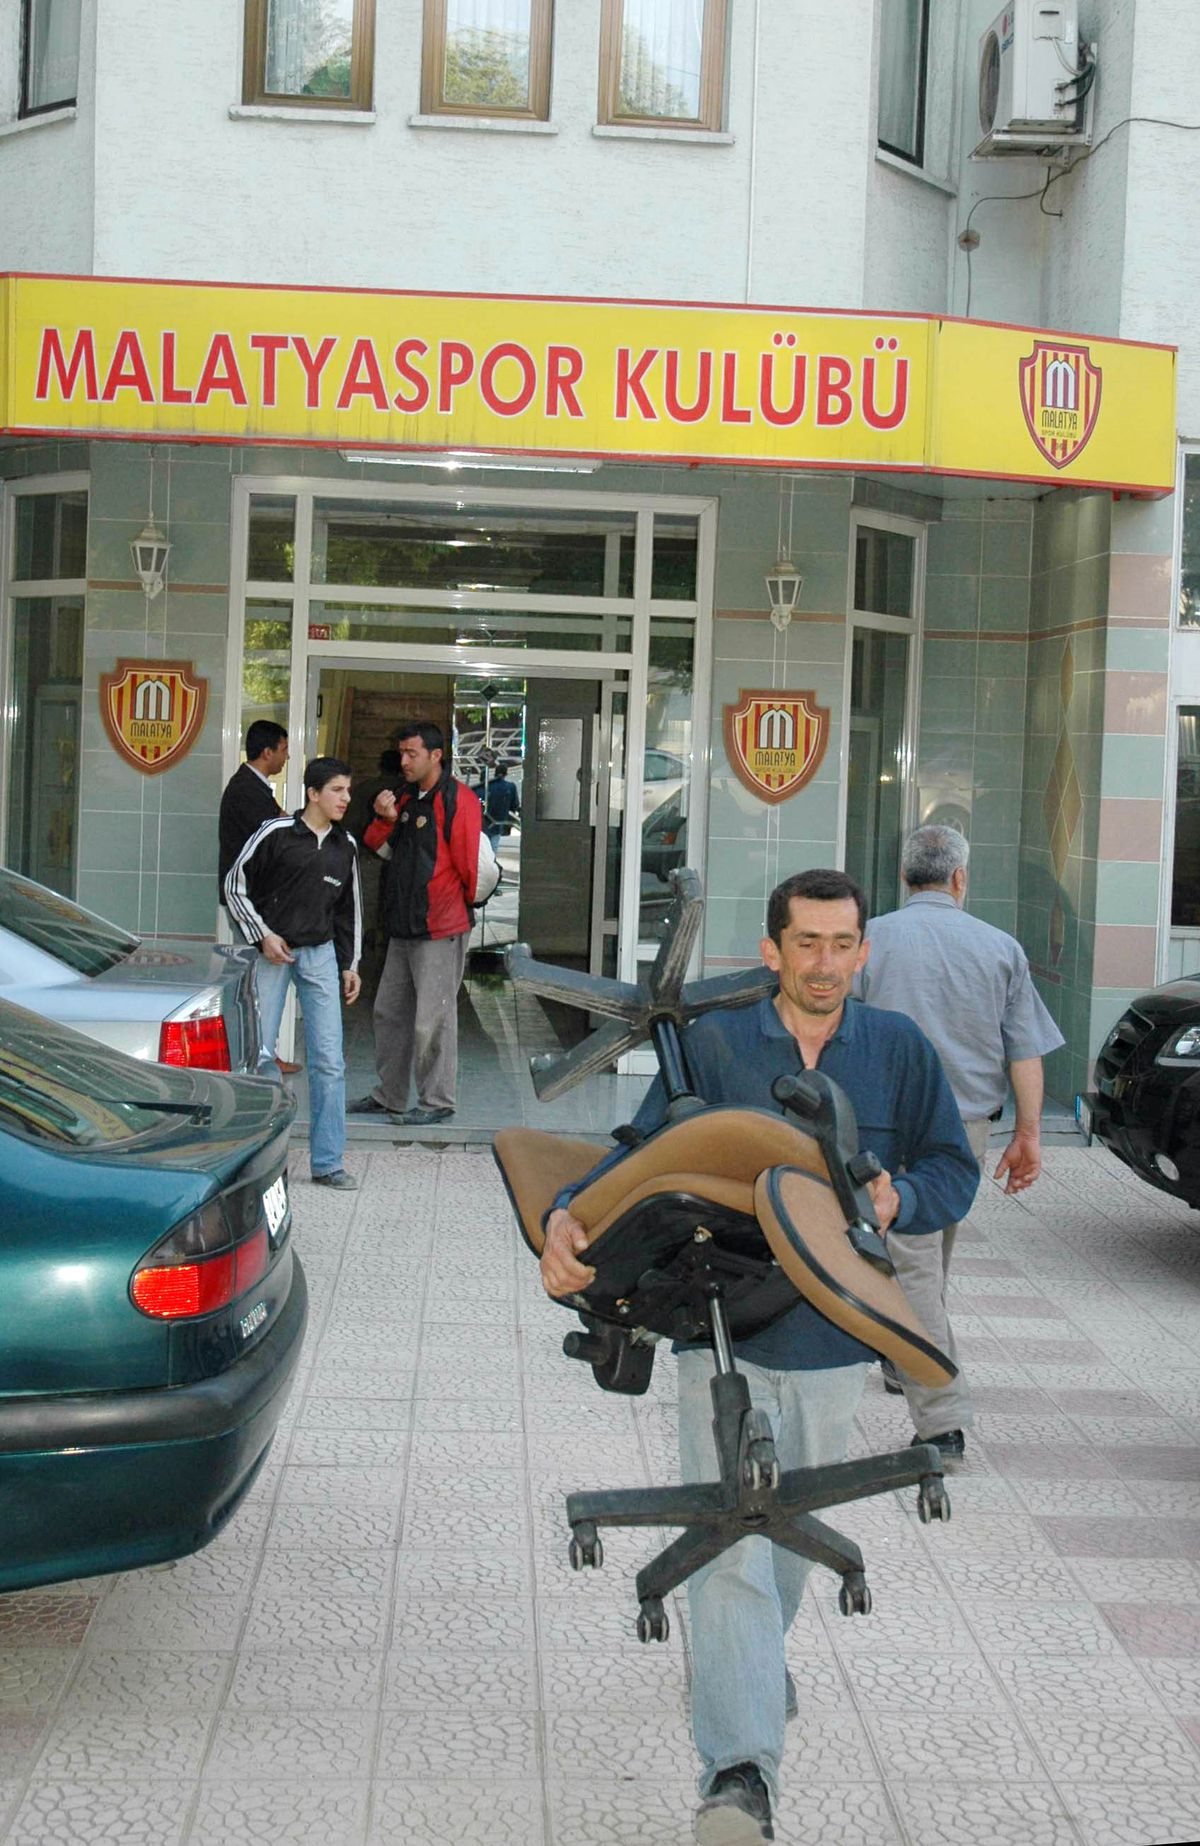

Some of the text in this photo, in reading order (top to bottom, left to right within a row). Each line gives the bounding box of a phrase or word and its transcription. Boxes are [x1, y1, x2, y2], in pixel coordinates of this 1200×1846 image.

[35, 328, 910, 430] MALATYASPOR KULÜBÜ
[1041, 410, 1078, 430] MALATYA
[130, 722, 172, 738] MALATYA
[755, 751, 796, 766] MALATYA
